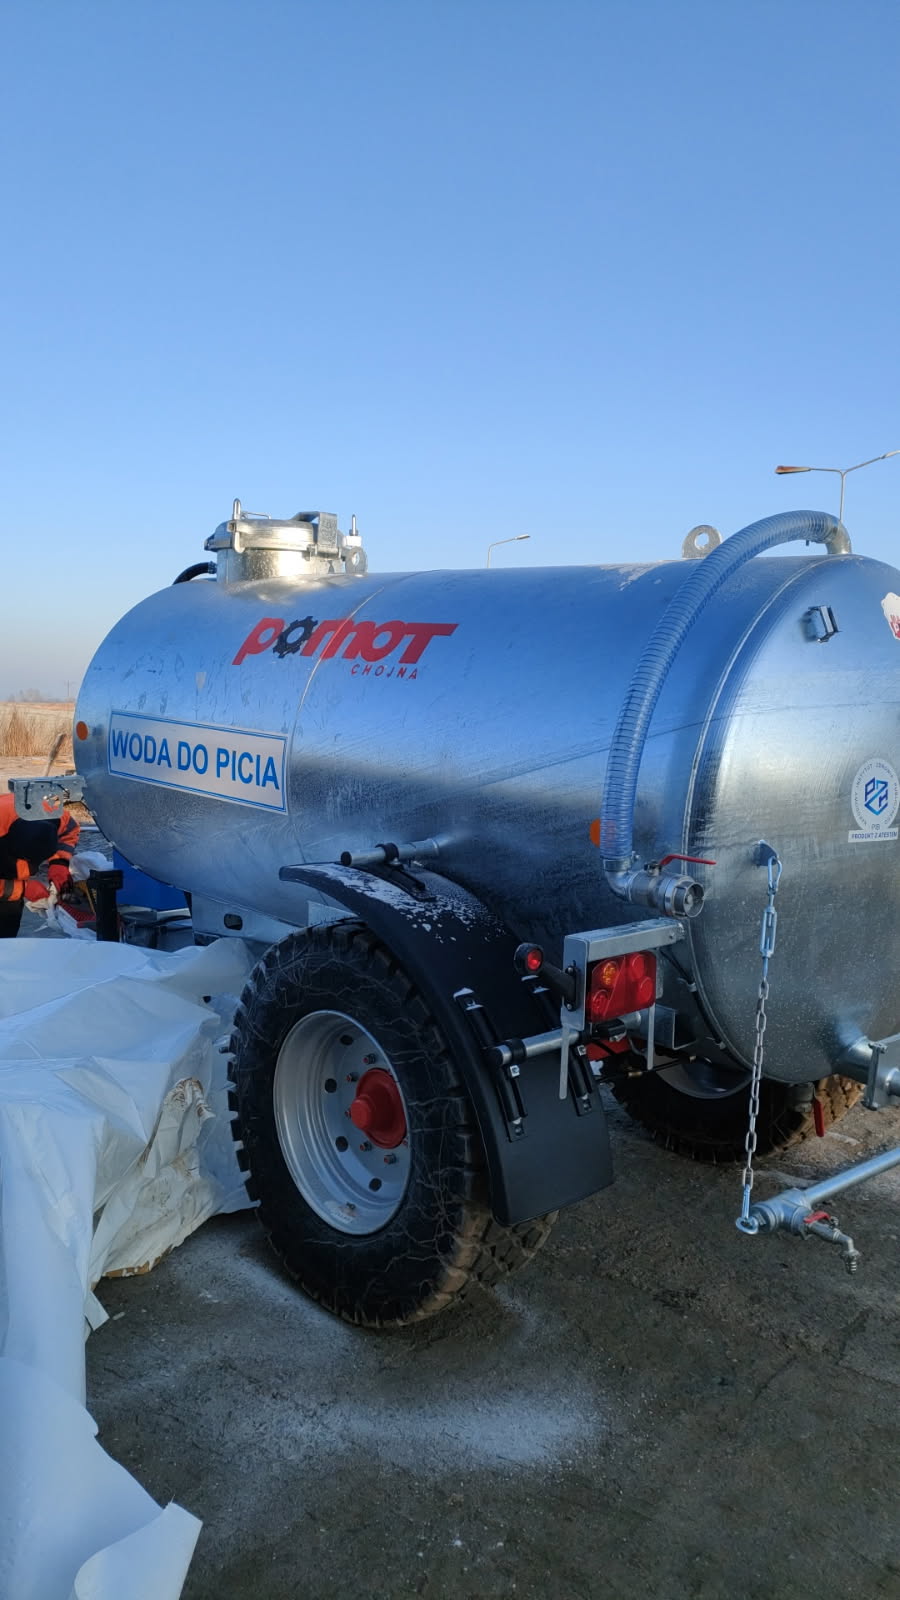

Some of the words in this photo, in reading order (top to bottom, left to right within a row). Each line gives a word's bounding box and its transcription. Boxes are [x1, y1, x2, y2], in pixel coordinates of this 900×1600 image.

[351, 664, 417, 679] CHOJNA
[112, 729, 172, 768] WODA
[177, 741, 209, 775] DO
[216, 747, 280, 790] PICIA
